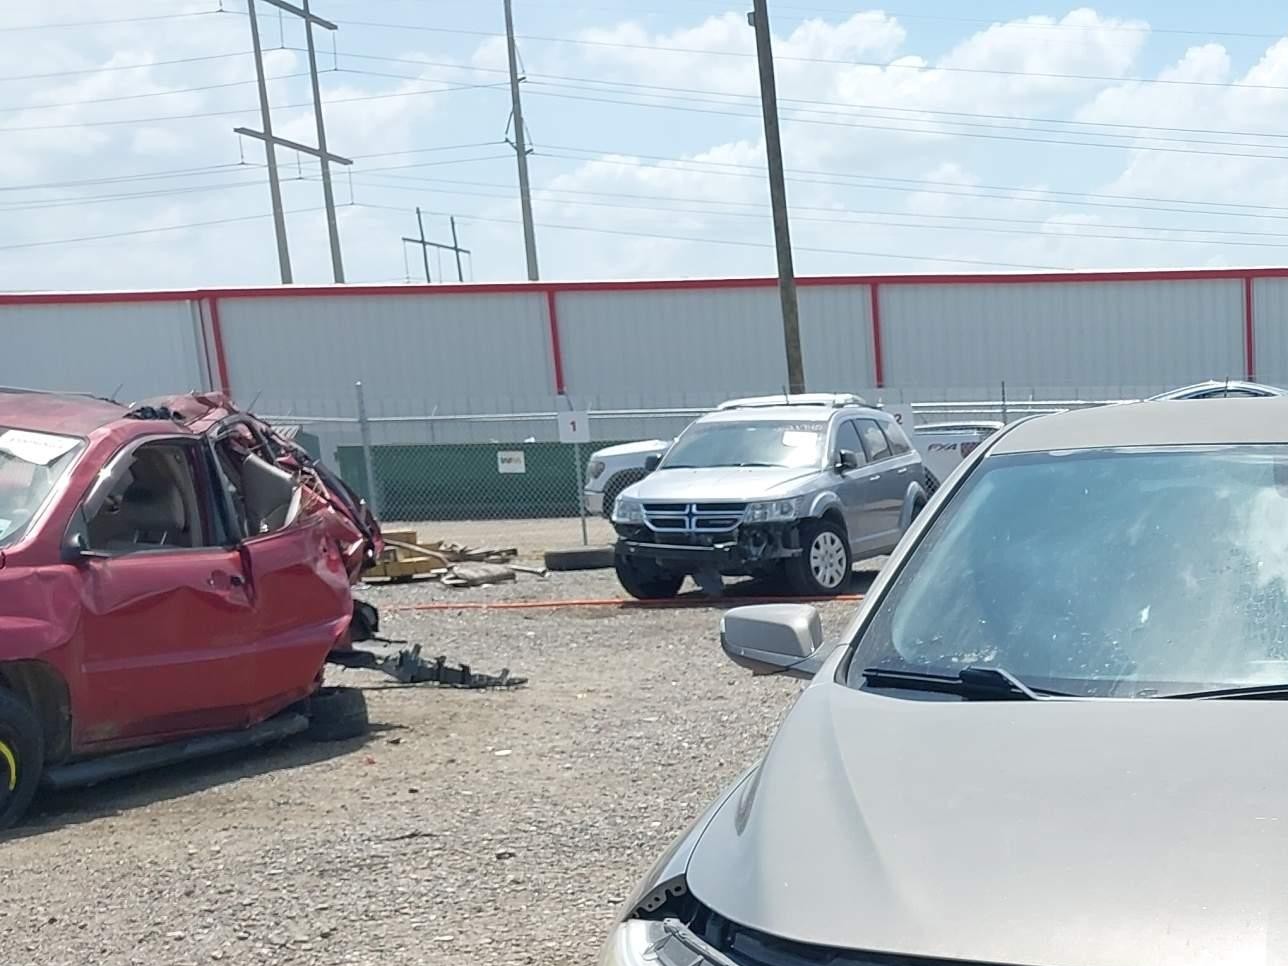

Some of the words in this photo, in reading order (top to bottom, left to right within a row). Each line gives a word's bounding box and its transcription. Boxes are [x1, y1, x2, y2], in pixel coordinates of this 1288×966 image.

[894, 413, 903, 425] 2
[570, 420, 577, 432] 1
[928, 443, 957, 451] FX4
